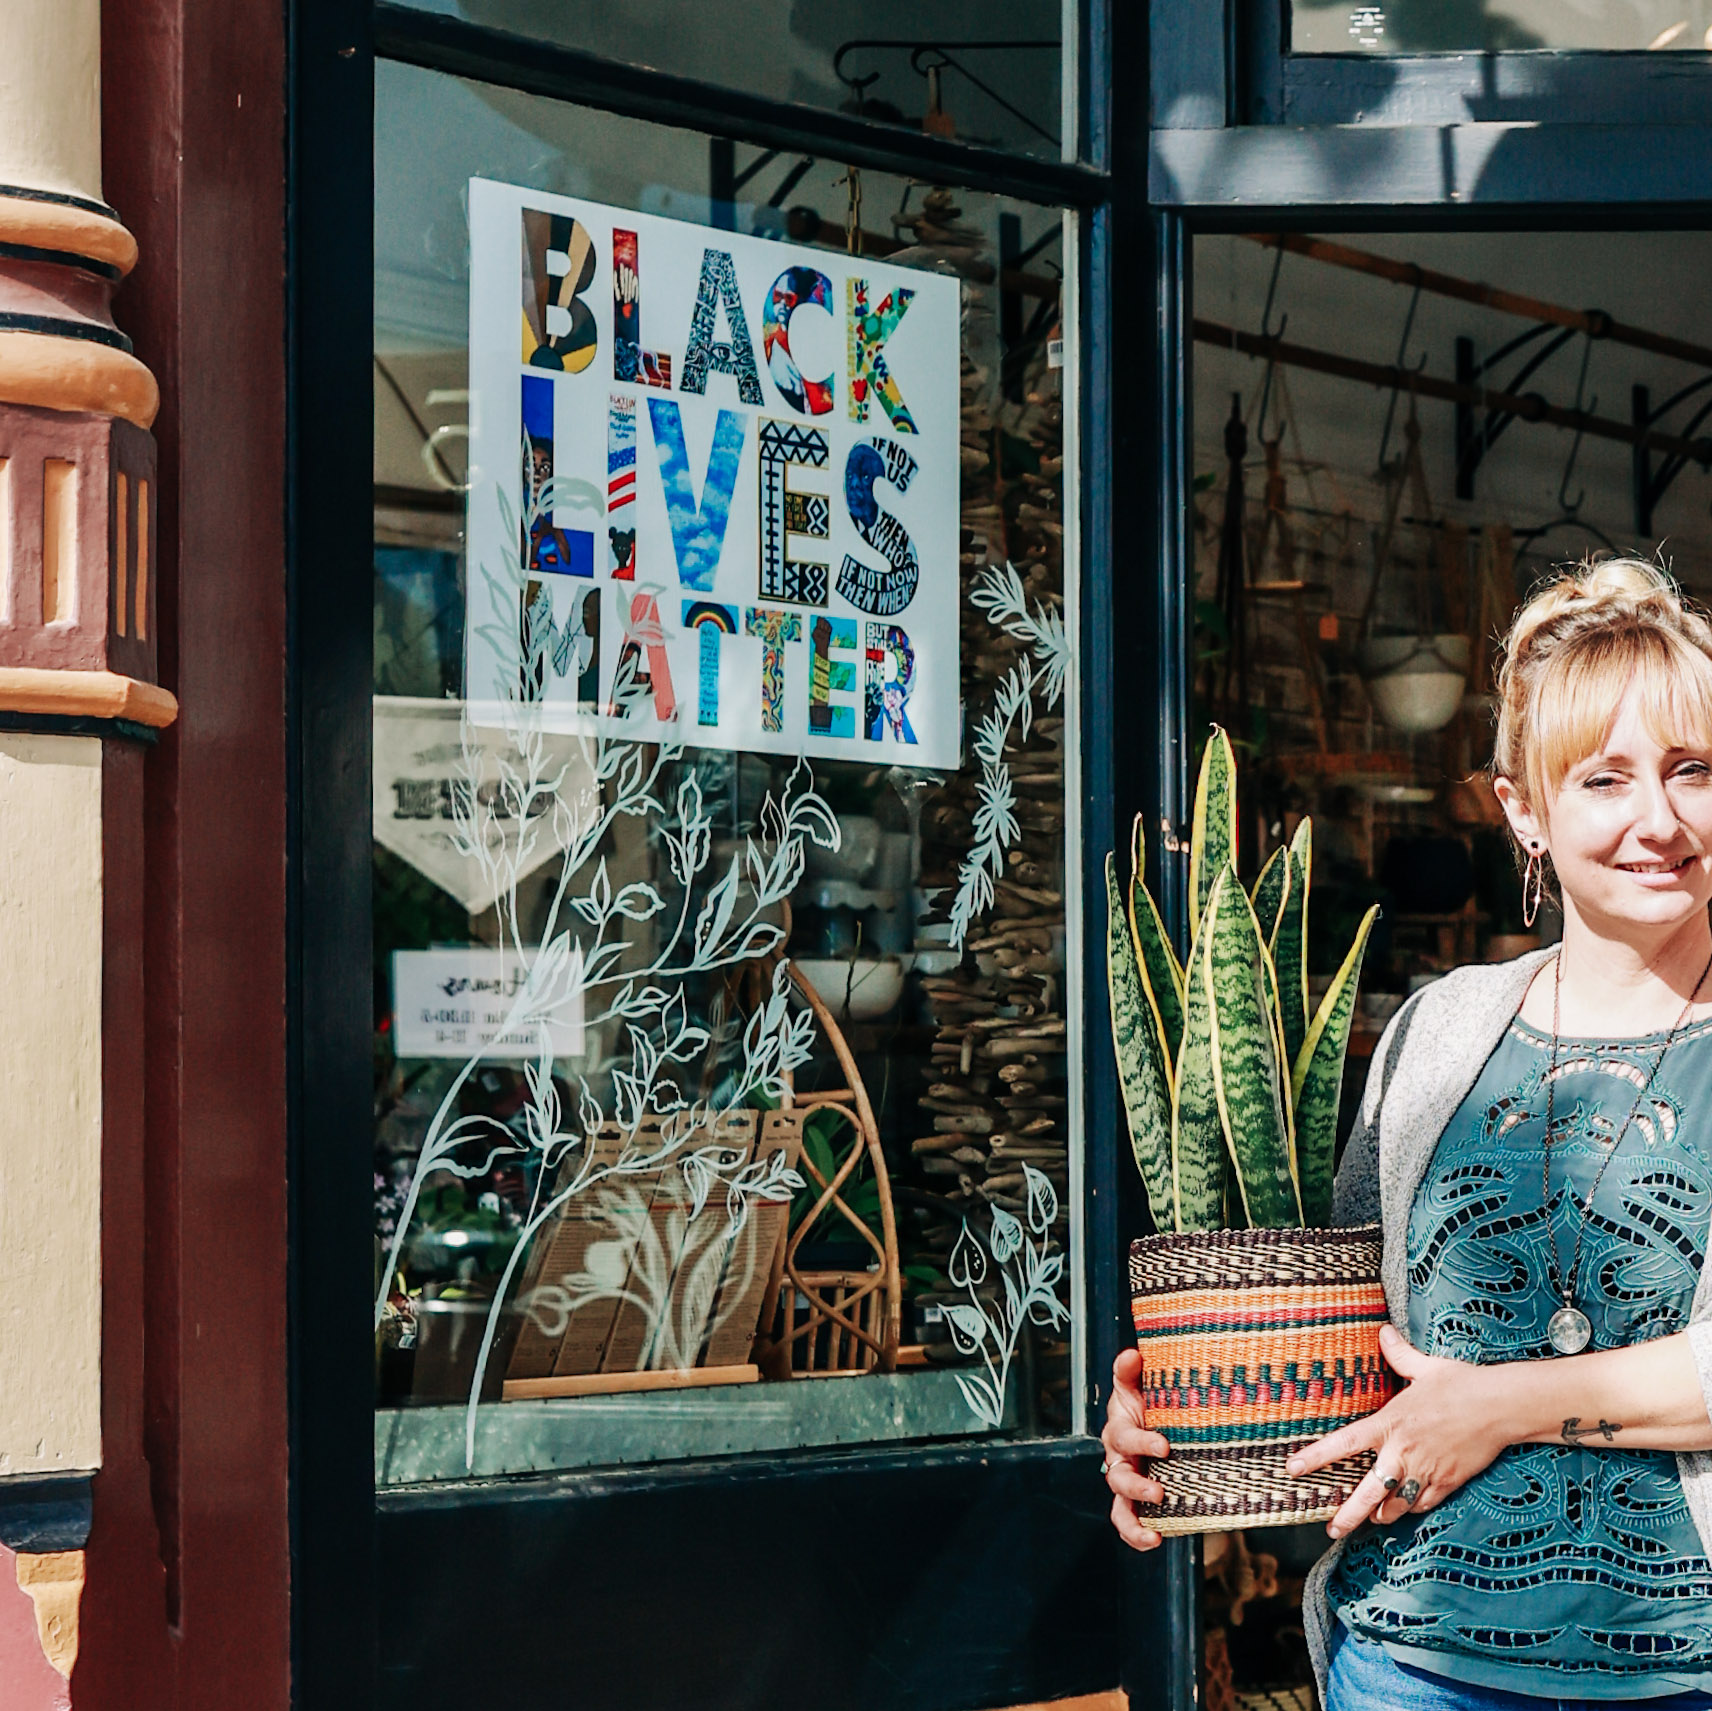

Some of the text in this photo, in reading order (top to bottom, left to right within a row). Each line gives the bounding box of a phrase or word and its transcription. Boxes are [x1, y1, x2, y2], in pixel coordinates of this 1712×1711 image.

[521, 207, 919, 435] BLACK
[872, 436, 919, 477] IF NOT
[521, 375, 919, 616] LIVES
[887, 462, 910, 493] US
[841, 556, 918, 591] IF NOT NOW
[838, 577, 915, 615] THEN WHEN?
[866, 623, 889, 639] BUT
[520, 579, 919, 744] MATTER
